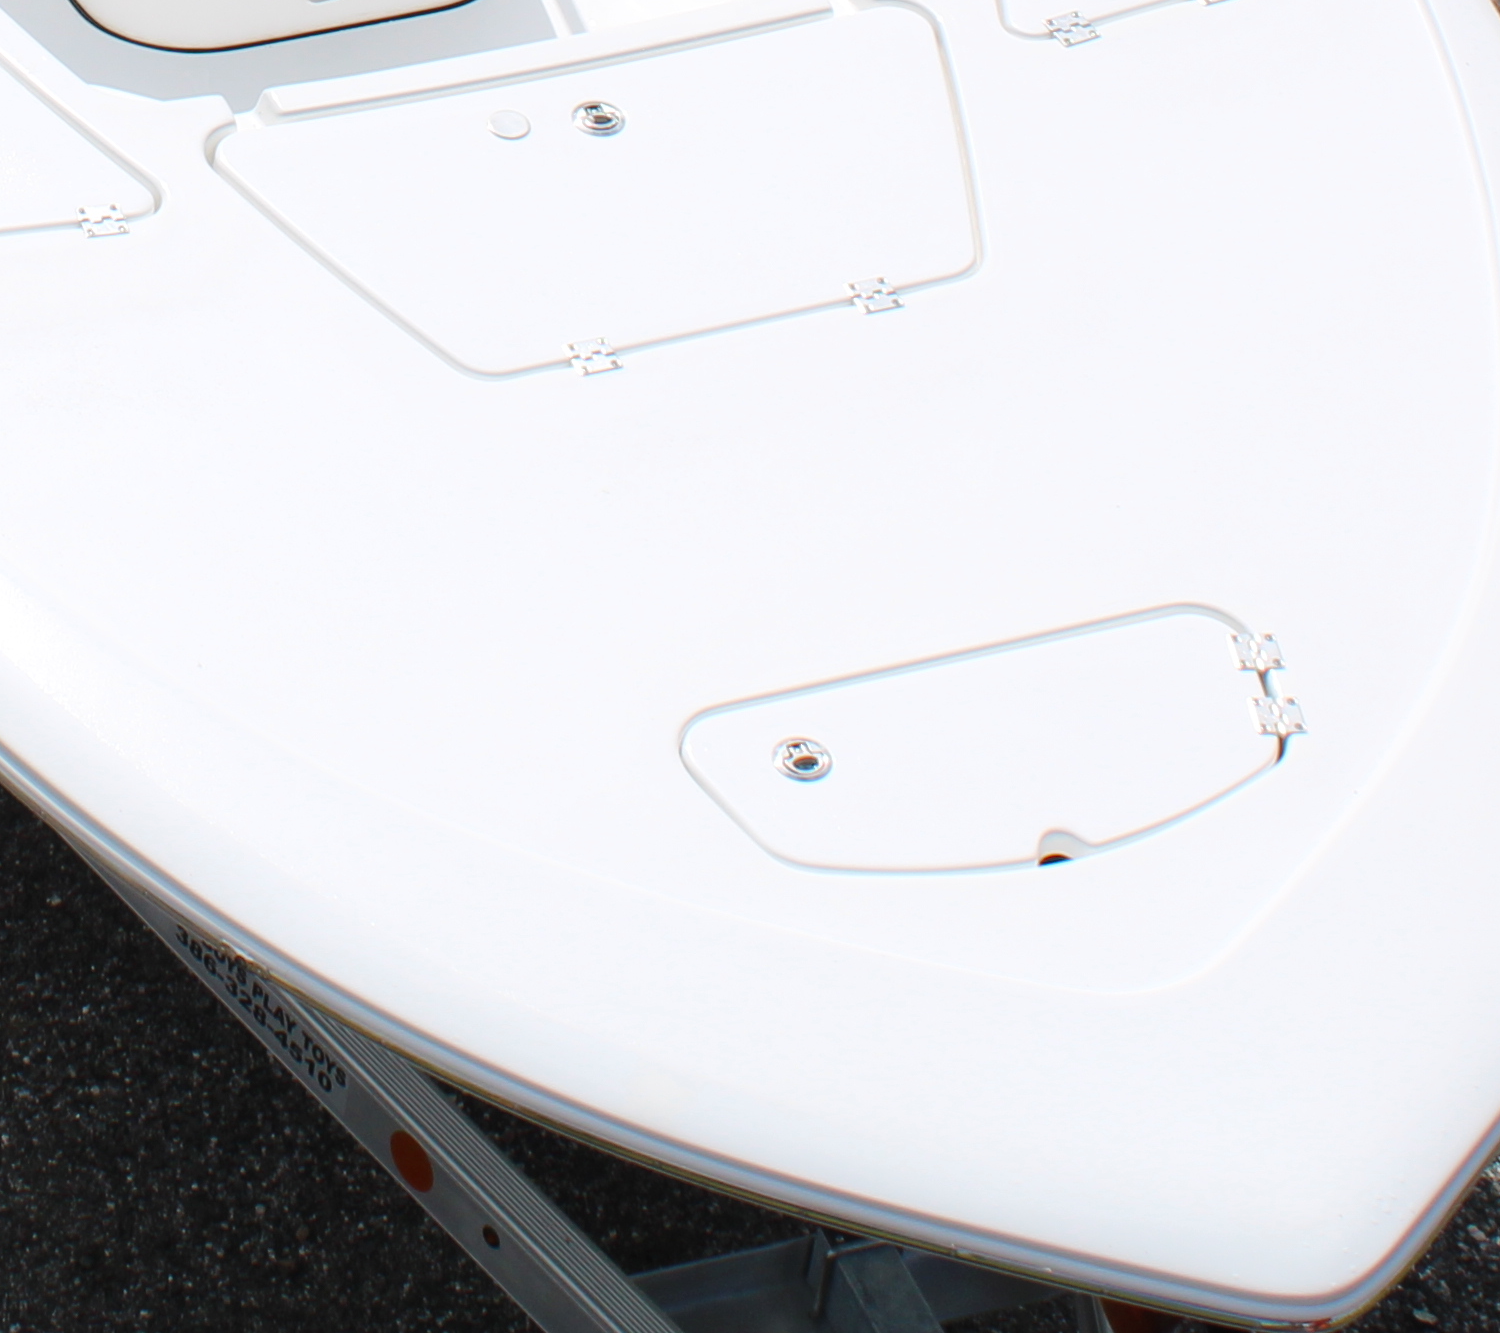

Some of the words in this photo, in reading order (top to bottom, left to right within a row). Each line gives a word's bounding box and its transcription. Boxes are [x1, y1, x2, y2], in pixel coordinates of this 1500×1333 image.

[175, 923, 333, 1093] 386-328-4510
[252, 981, 298, 1034] PLAY
[302, 1030, 347, 1088] TOYS
